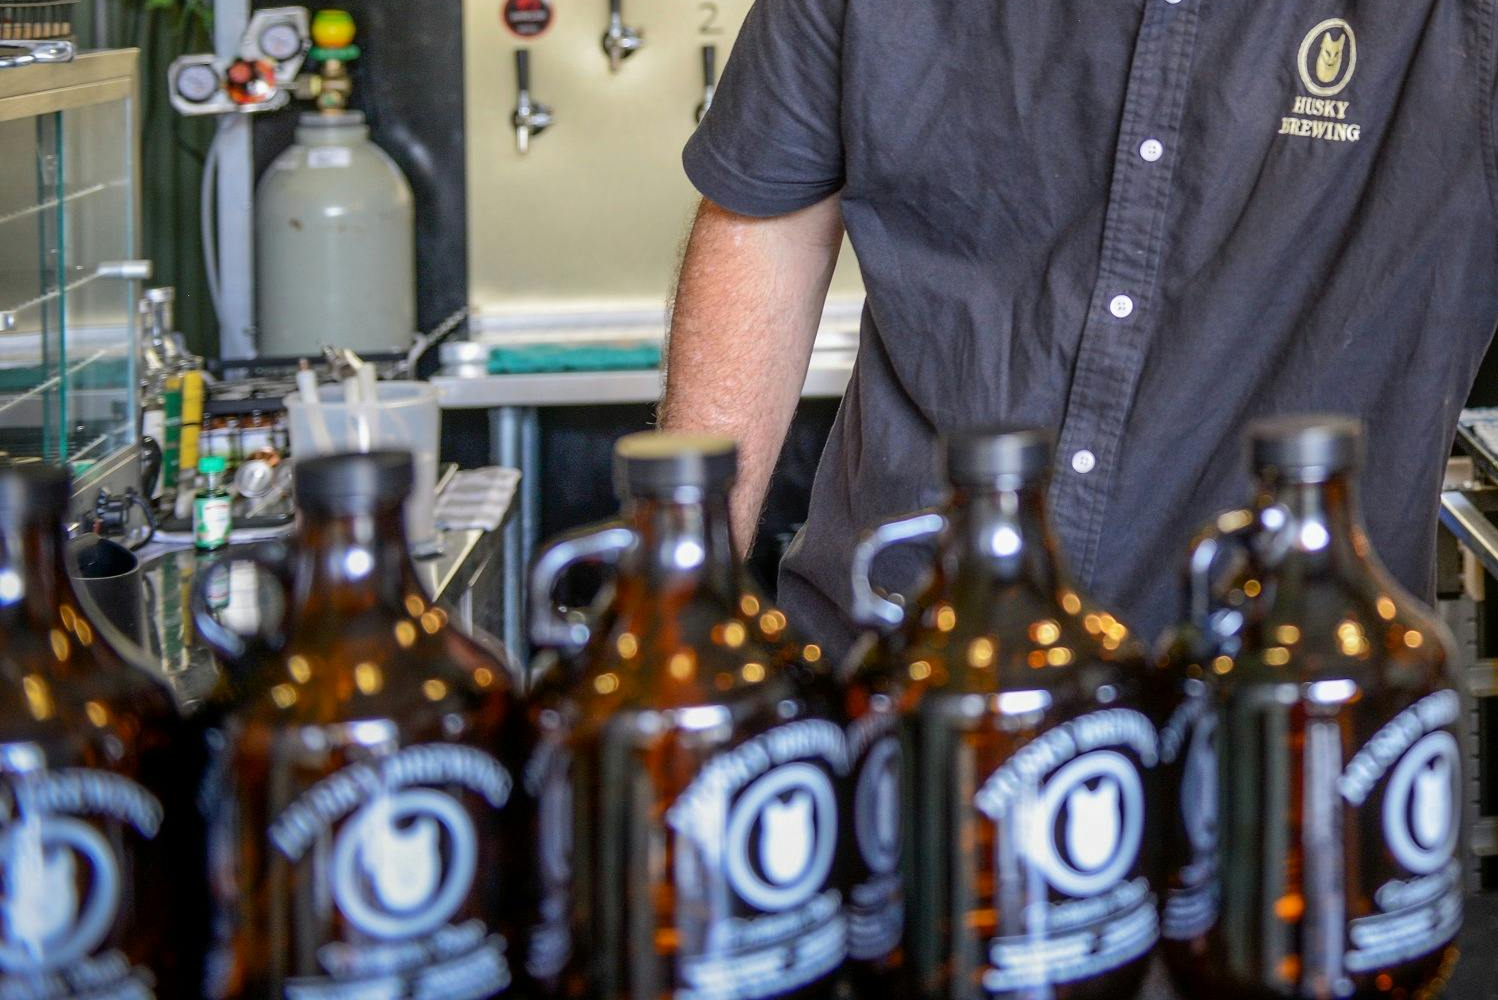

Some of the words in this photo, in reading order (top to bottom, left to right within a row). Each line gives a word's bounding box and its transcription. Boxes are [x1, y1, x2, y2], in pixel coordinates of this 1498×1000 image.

[700, 2, 723, 34] 2
[1292, 96, 1349, 119] HUSKY
[1278, 117, 1360, 142] BREWING
